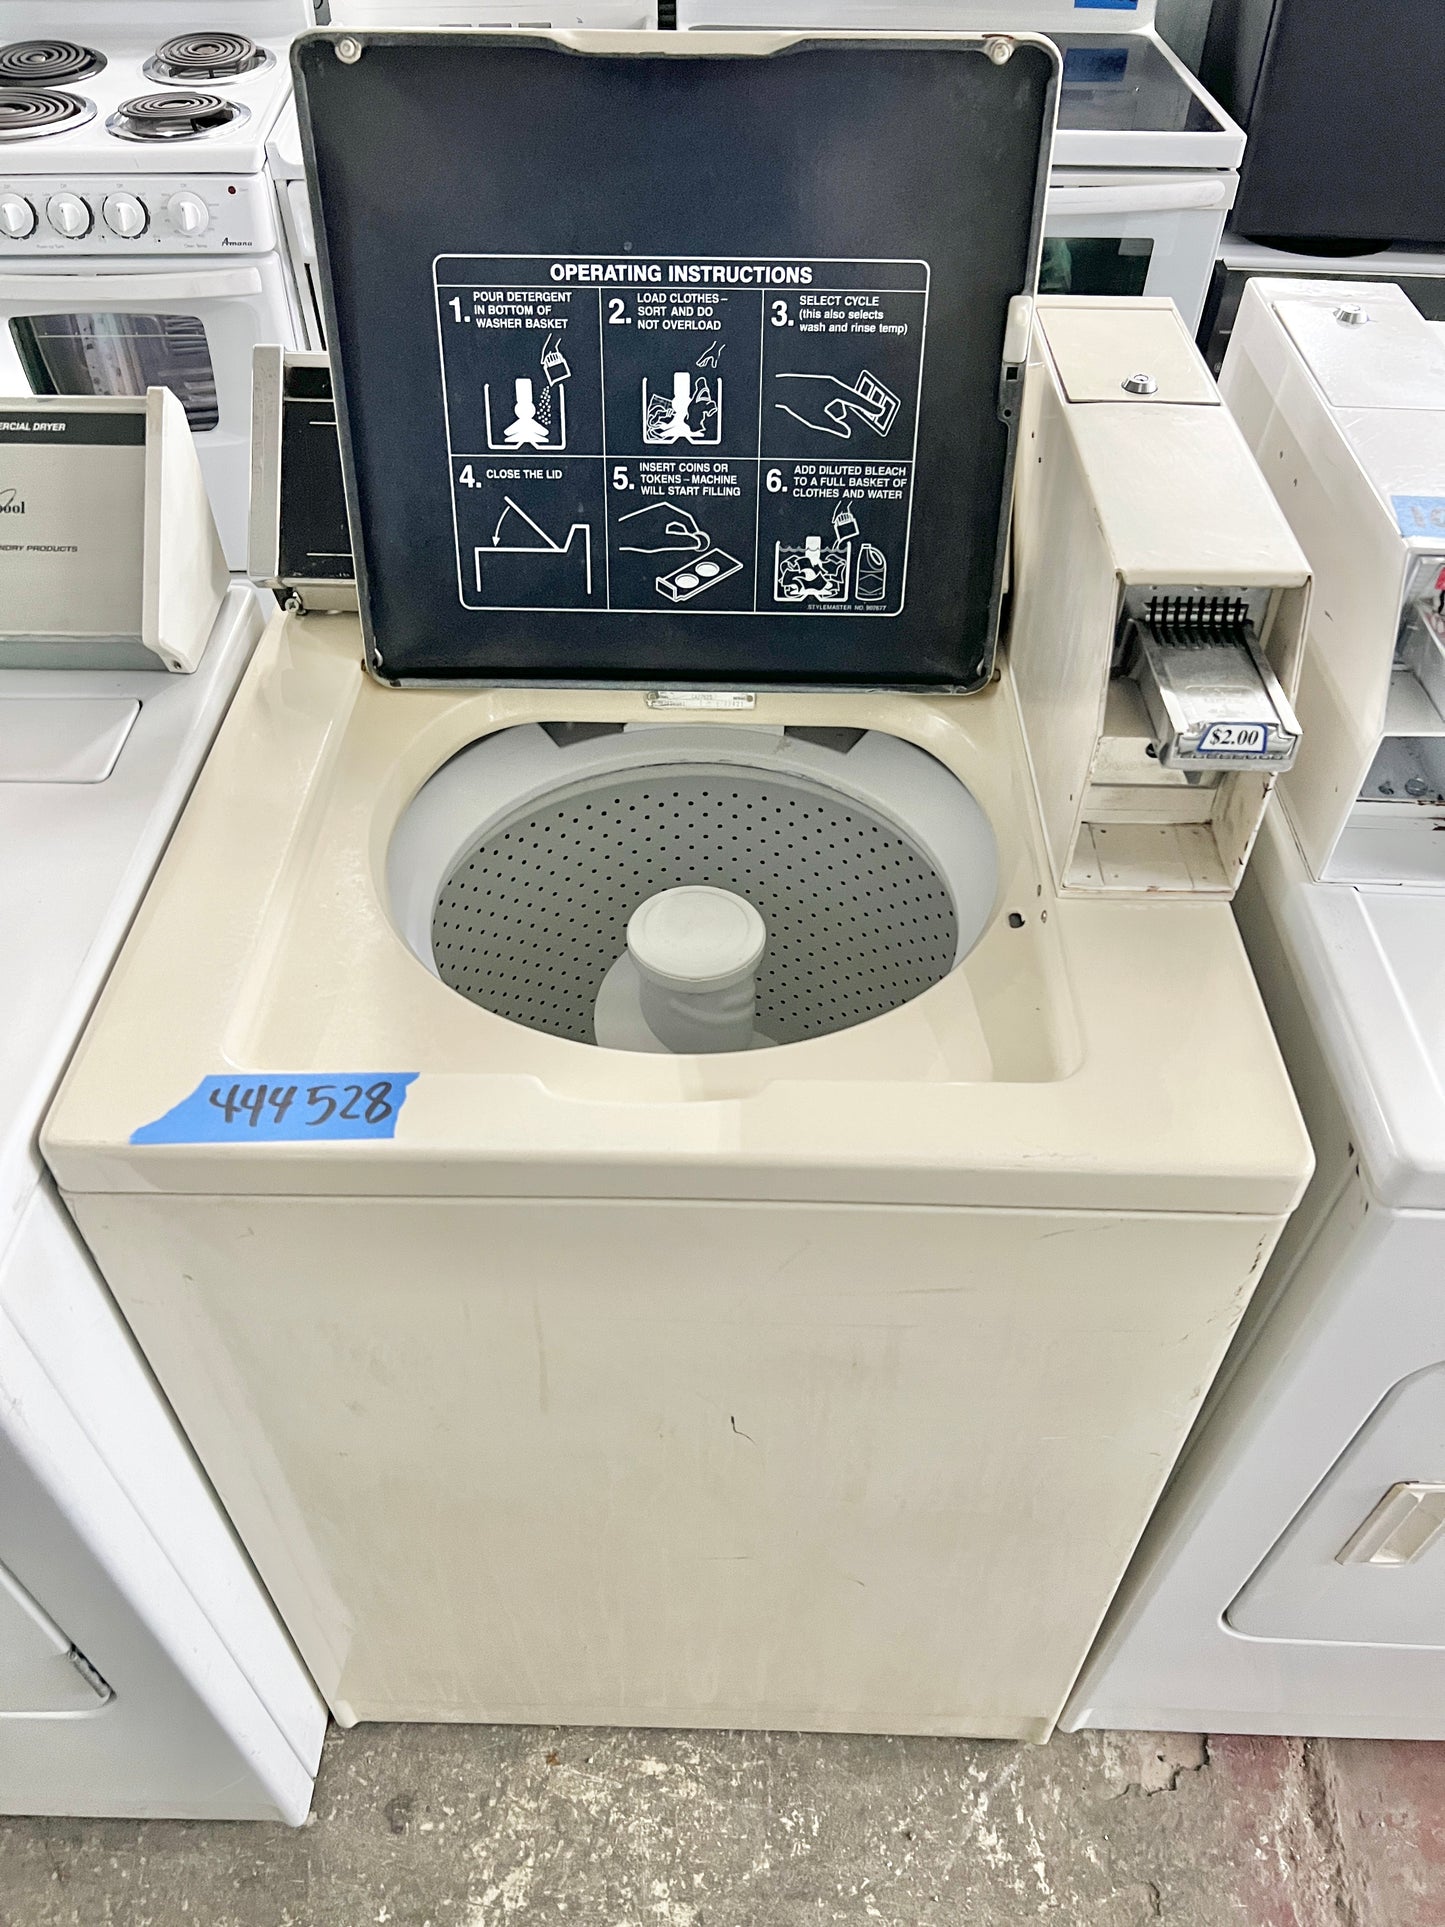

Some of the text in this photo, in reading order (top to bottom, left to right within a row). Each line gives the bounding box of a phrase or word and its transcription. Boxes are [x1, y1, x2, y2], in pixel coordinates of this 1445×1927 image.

[222, 237, 253, 247] Amana
[550, 264, 813, 284] OPERATING INSTRUCTIONS
[473, 291, 572, 303] POUR DETERGENT
[637, 293, 667, 304] LOAD
[799, 296, 880, 307] SELECT CYCLE
[449, 297, 471, 323] 1.
[474, 305, 552, 316] IN BOTTOM OF
[608, 298, 632, 325] 2.
[637, 306, 714, 317] SORT AND DO
[771, 300, 794, 327] 3.
[799, 309, 884, 320] (this also selects
[476, 318, 569, 329] WASHER BASKET
[637, 320, 722, 331] NOT OVERLOAD
[800, 323, 908, 336] wash and rinse temp)
[32, 422, 66, 431] DRYER
[639, 462, 729, 473] INSERT COINS OR
[794, 465, 906, 477] ADD DILUTED BLEACH
[459, 464, 482, 489] 4.
[486, 469, 563, 480] CLOSE THE LID
[612, 466, 635, 490] 5.
[640, 474, 682, 484] TOKENS
[692, 475, 738, 485] MACHINE
[766, 469, 788, 493] 6.
[794, 477, 908, 488] TO A FULL BASKET OF
[641, 486, 741, 497] WILL START FILLING
[793, 488, 903, 499] CLOTHES AND WATER
[1210, 728, 1259, 745] $2.00
